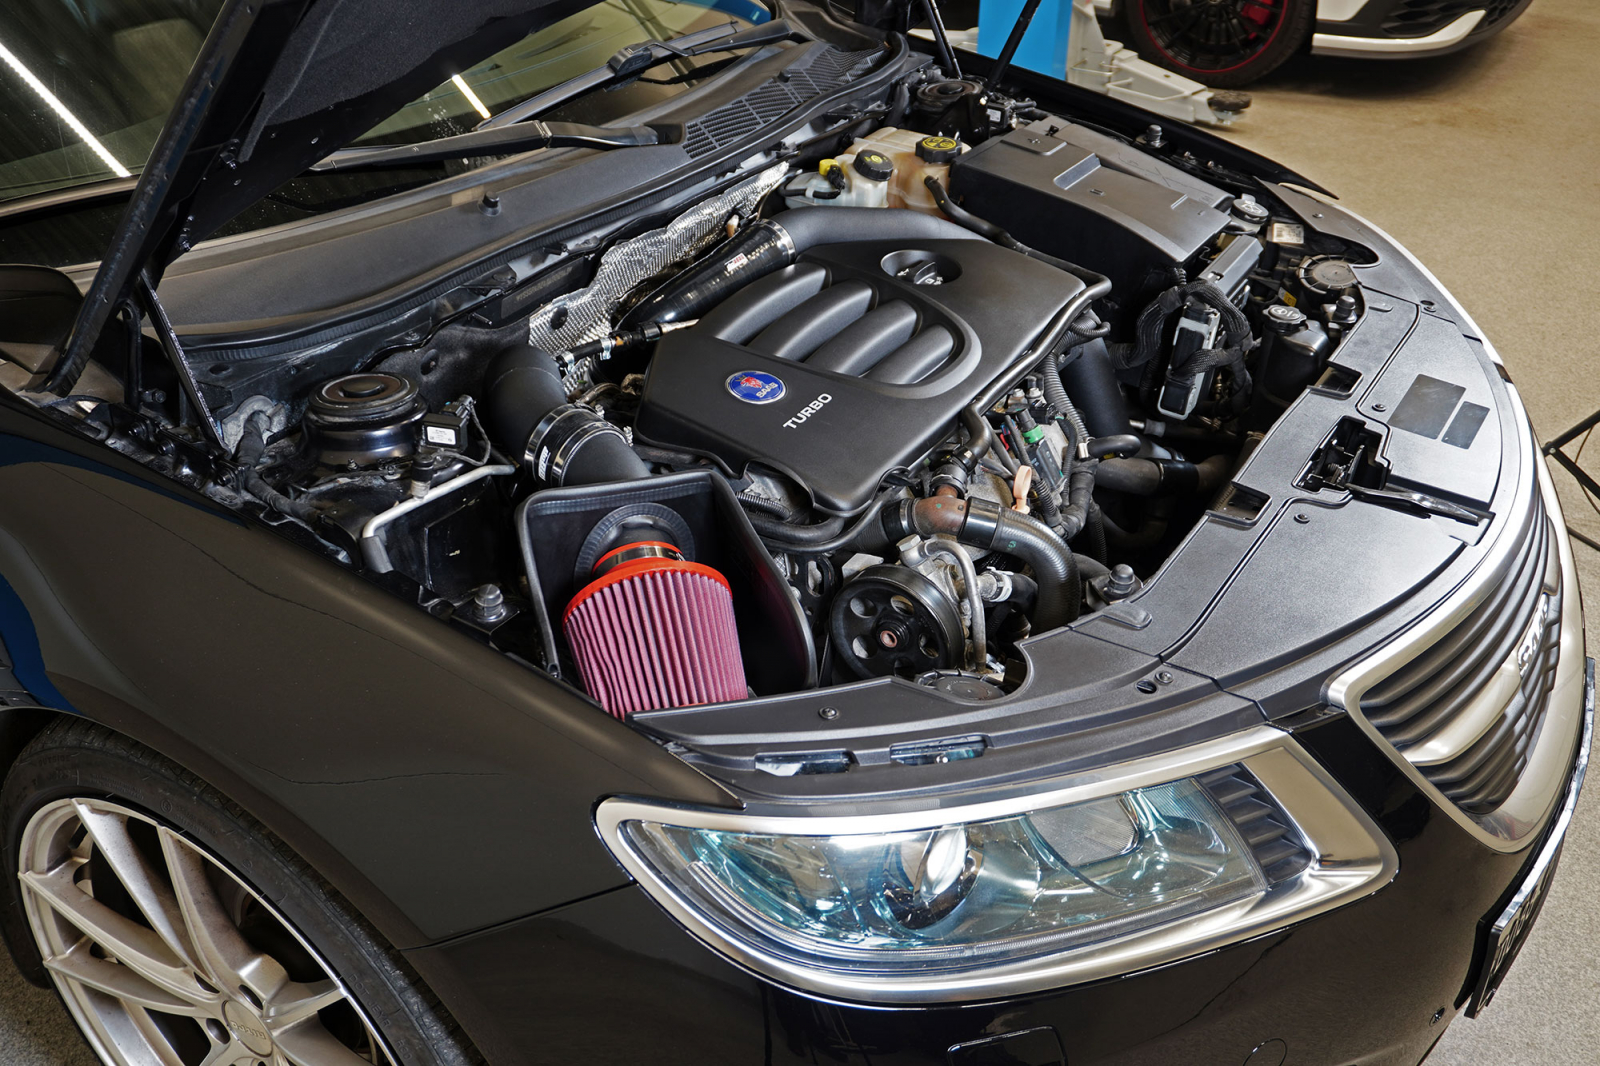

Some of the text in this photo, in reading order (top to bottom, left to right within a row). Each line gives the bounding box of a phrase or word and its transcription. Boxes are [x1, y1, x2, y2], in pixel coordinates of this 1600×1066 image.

[755, 382, 778, 398] SAAB
[782, 393, 832, 429] TURBO
[349, 974, 370, 996] DOT
